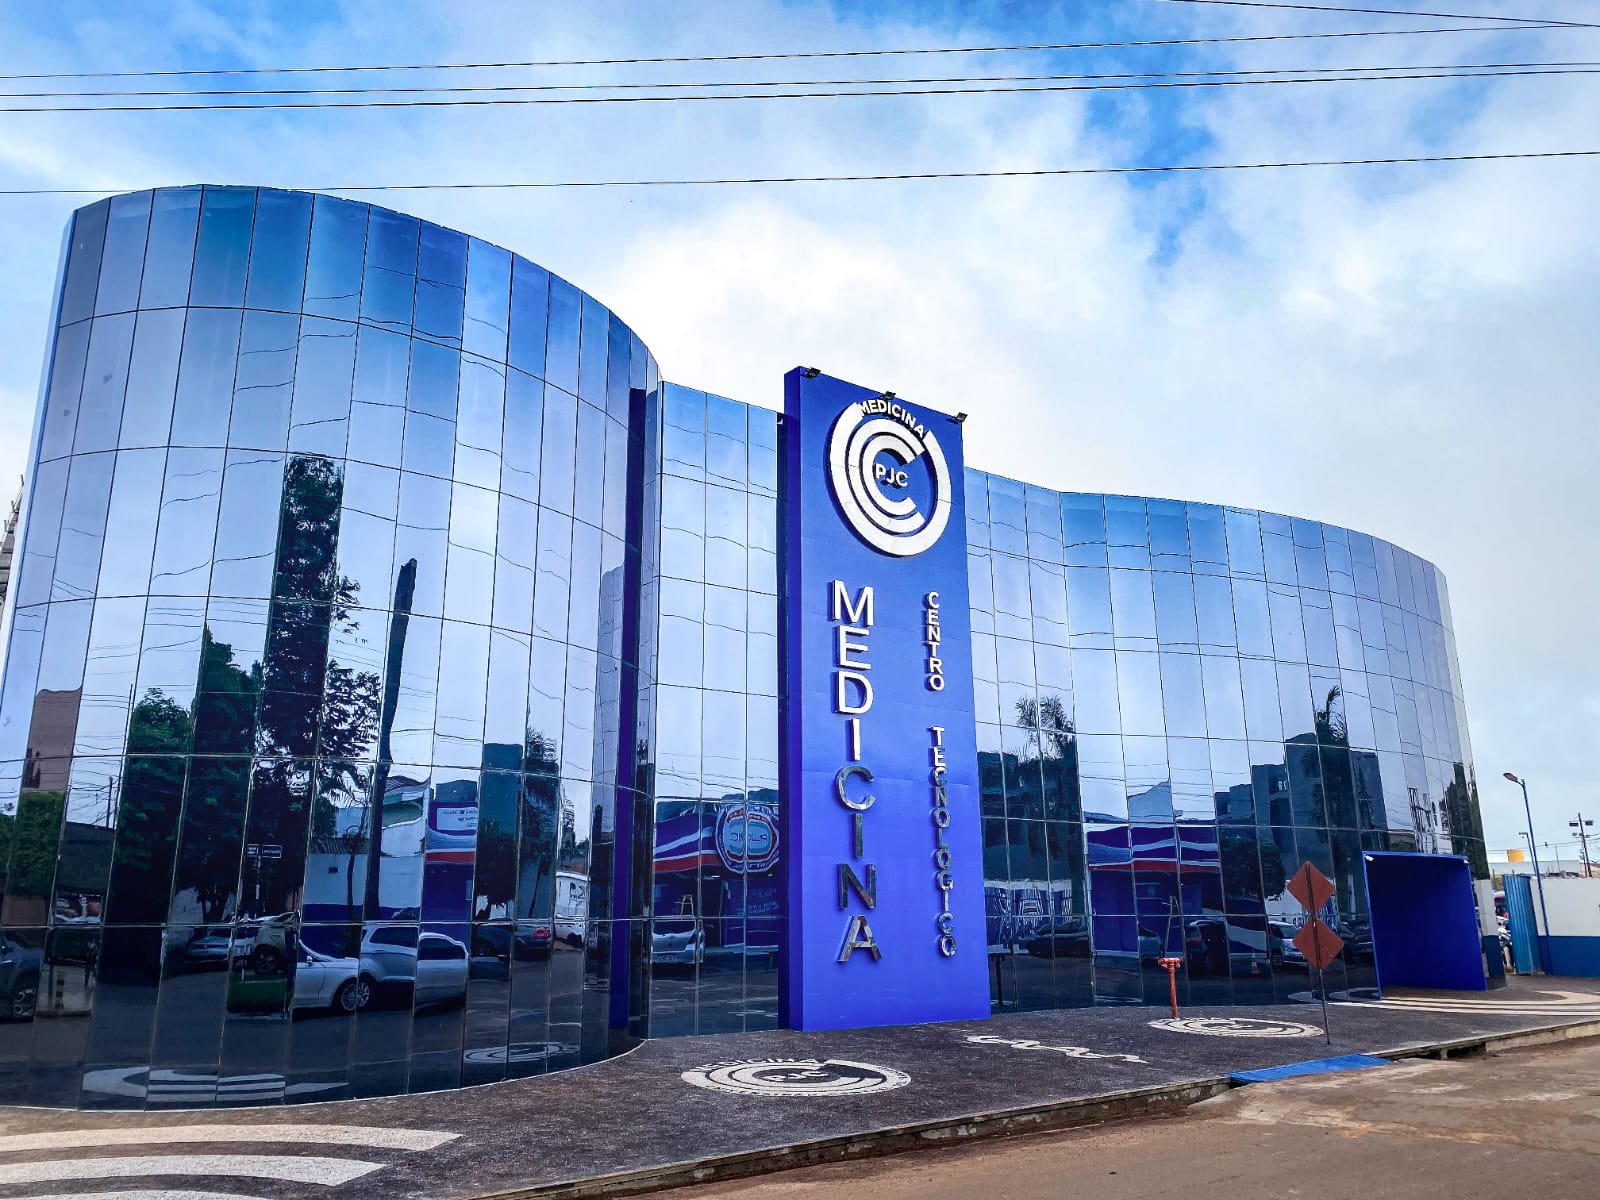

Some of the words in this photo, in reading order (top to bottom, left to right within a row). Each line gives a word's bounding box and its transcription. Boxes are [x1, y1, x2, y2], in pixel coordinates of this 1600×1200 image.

[857, 399, 924, 438] MEDICINA
[875, 463, 909, 487] PJC
[926, 591, 945, 691] CENTRO
[833, 579, 882, 962] MEDICINA
[930, 726, 957, 957] TECNOLOGICO
